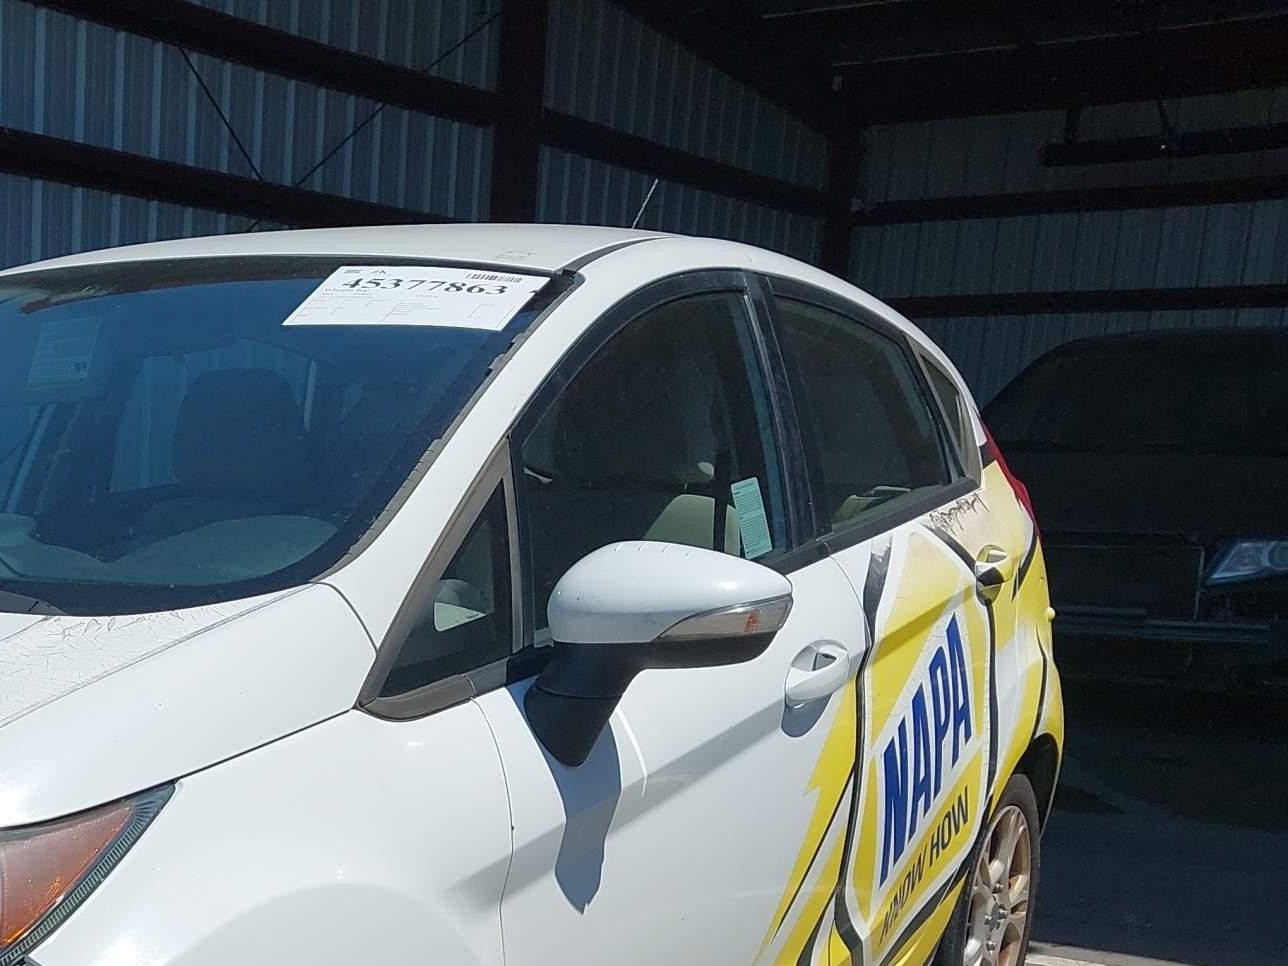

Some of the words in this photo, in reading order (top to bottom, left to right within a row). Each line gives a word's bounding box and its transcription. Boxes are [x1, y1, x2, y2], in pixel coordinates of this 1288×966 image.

[341, 277, 509, 295] 45377863
[879, 611, 973, 890] NAPA
[878, 843, 928, 947] KNOW
[928, 784, 969, 868] HOW
